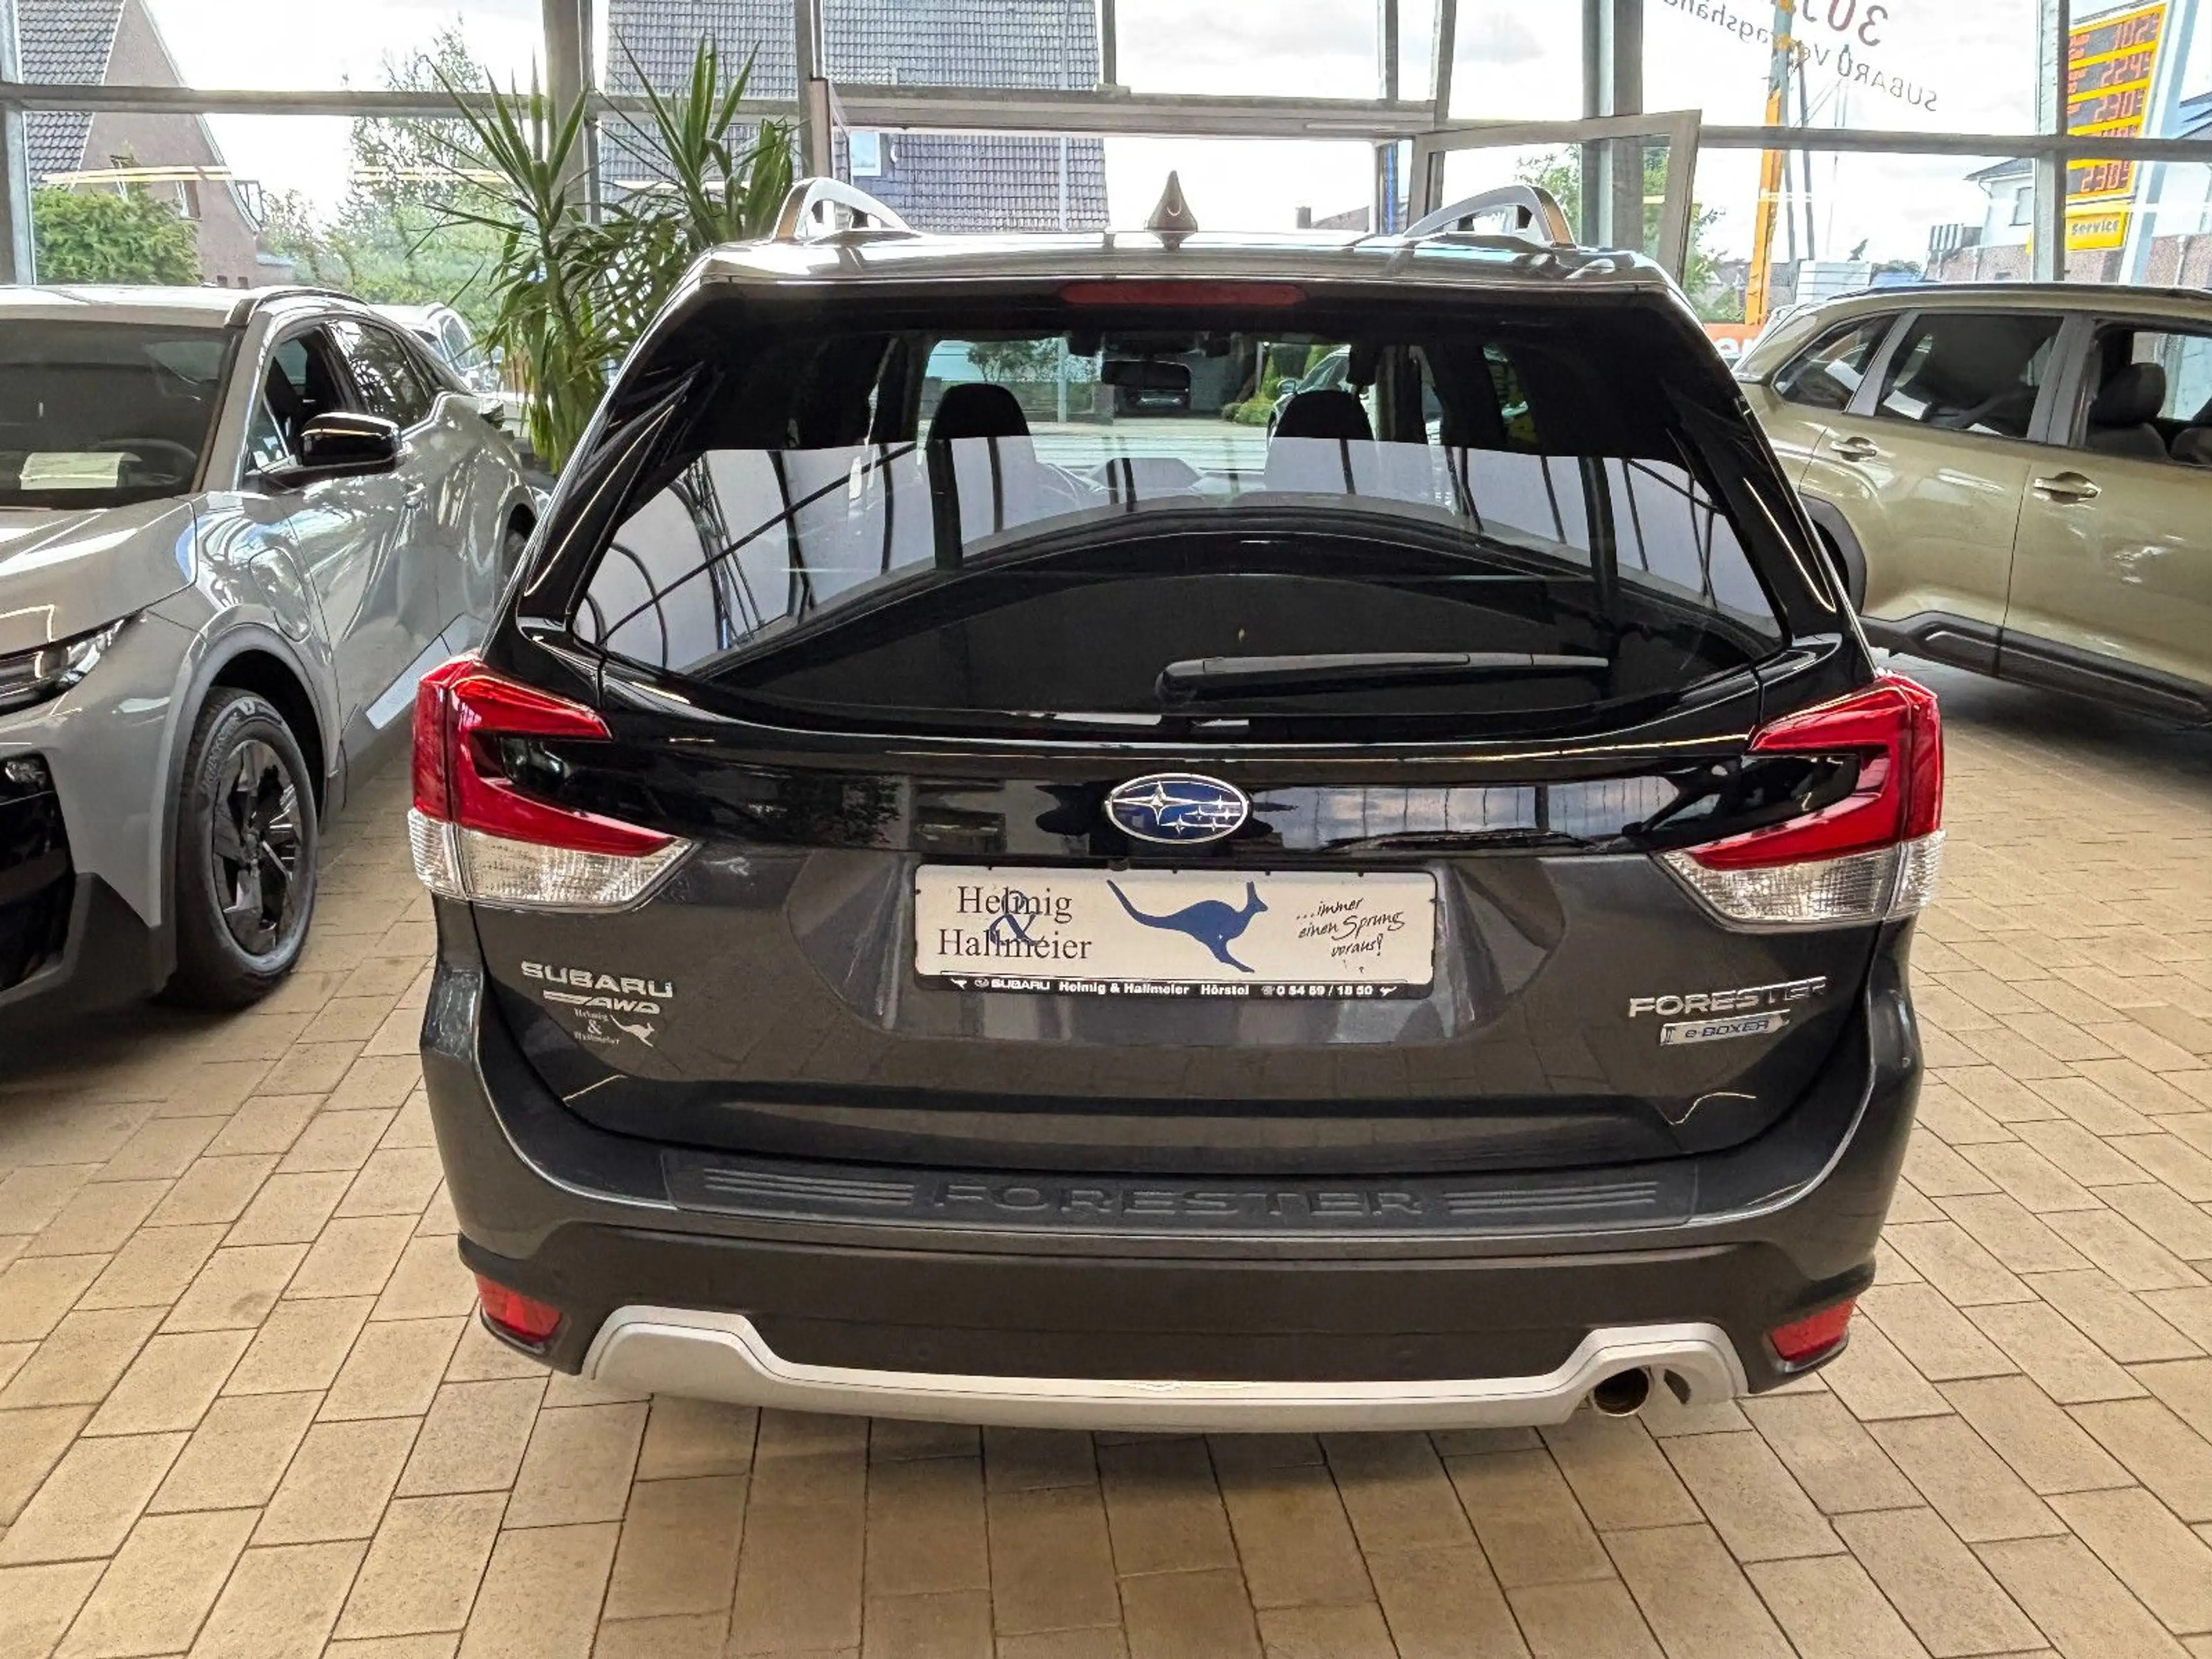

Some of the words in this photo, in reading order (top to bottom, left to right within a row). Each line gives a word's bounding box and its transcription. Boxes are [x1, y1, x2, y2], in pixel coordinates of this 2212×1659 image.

[957, 885, 1073, 924] Helmig
[937, 928, 1092, 959] Hallmeier
[1298, 922, 1339, 938] einen
[1331, 911, 1406, 941] Sprung
[521, 960, 673, 998] SUBARU
[991, 979, 1050, 991] SUBARU
[1110, 982, 1120, 994] &
[1628, 975, 1828, 1018] FORESTER
[933, 1181, 1423, 1217] FORESTER
